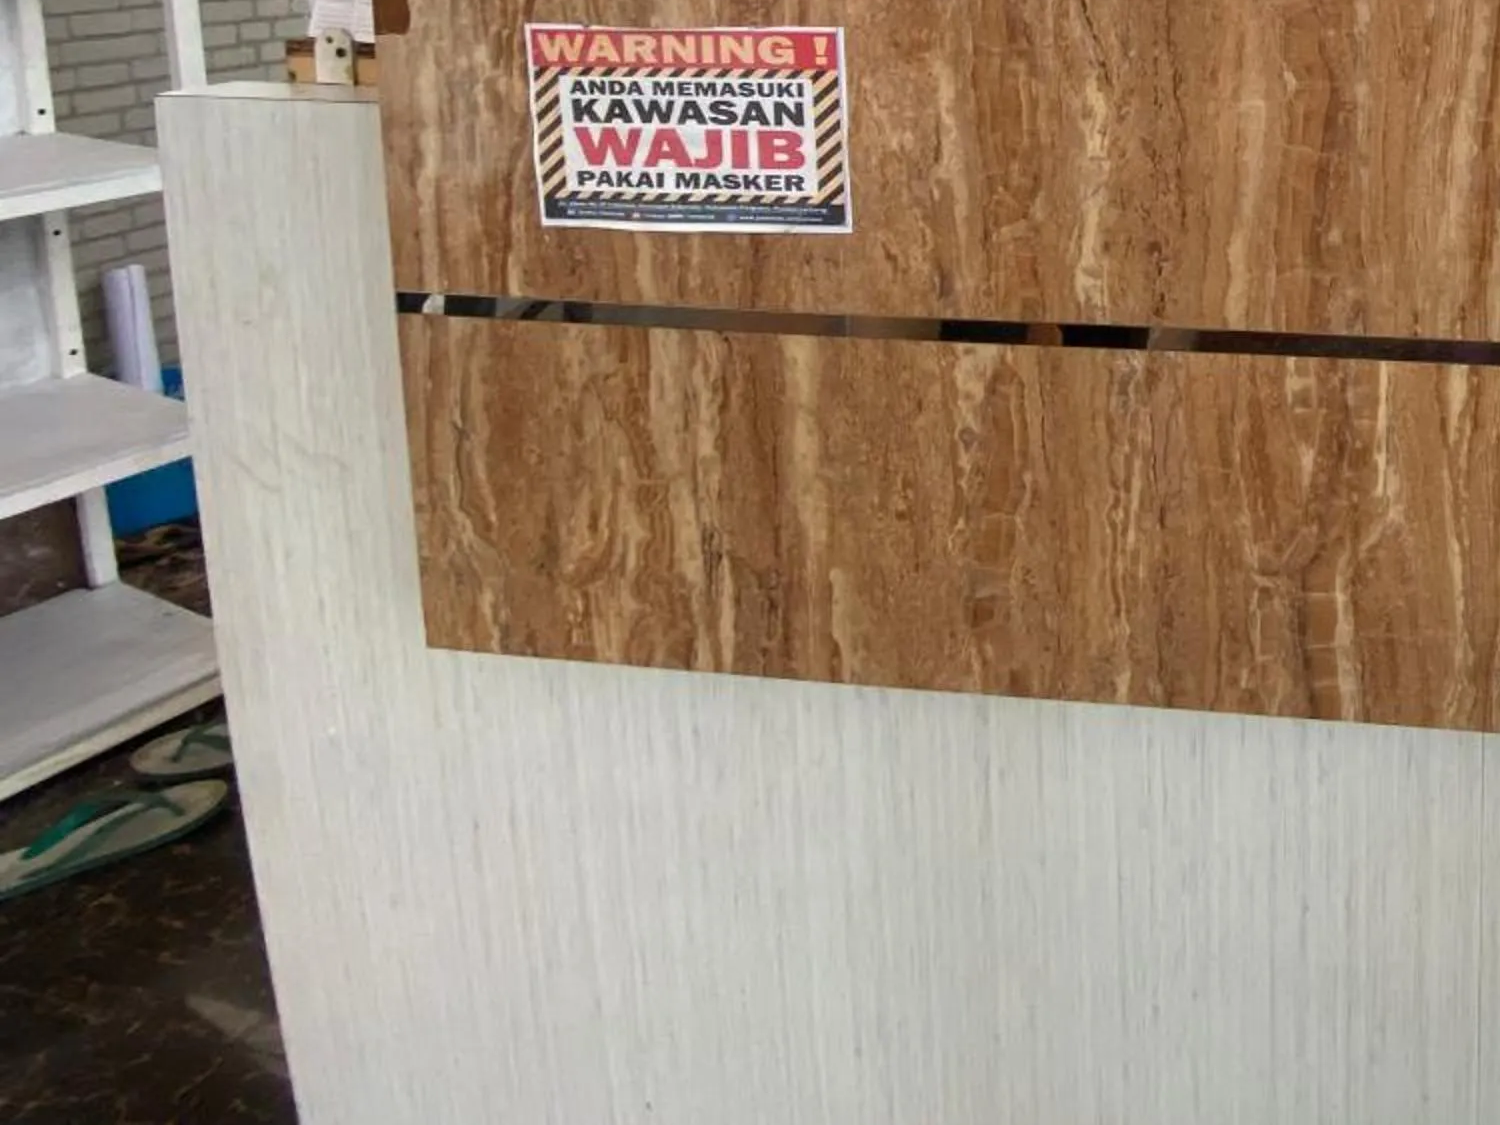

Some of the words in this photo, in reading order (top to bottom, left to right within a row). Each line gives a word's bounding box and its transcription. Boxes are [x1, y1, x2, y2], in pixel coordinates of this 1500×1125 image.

[535, 32, 797, 65] WARNING
[813, 36, 829, 66] !
[570, 80, 645, 97] ANDA
[652, 80, 805, 99] MEMASUKI
[571, 98, 806, 127] KAWASAN
[573, 126, 807, 170] WAJIB
[577, 170, 665, 189] PAKAI
[675, 171, 806, 192] MASKER
